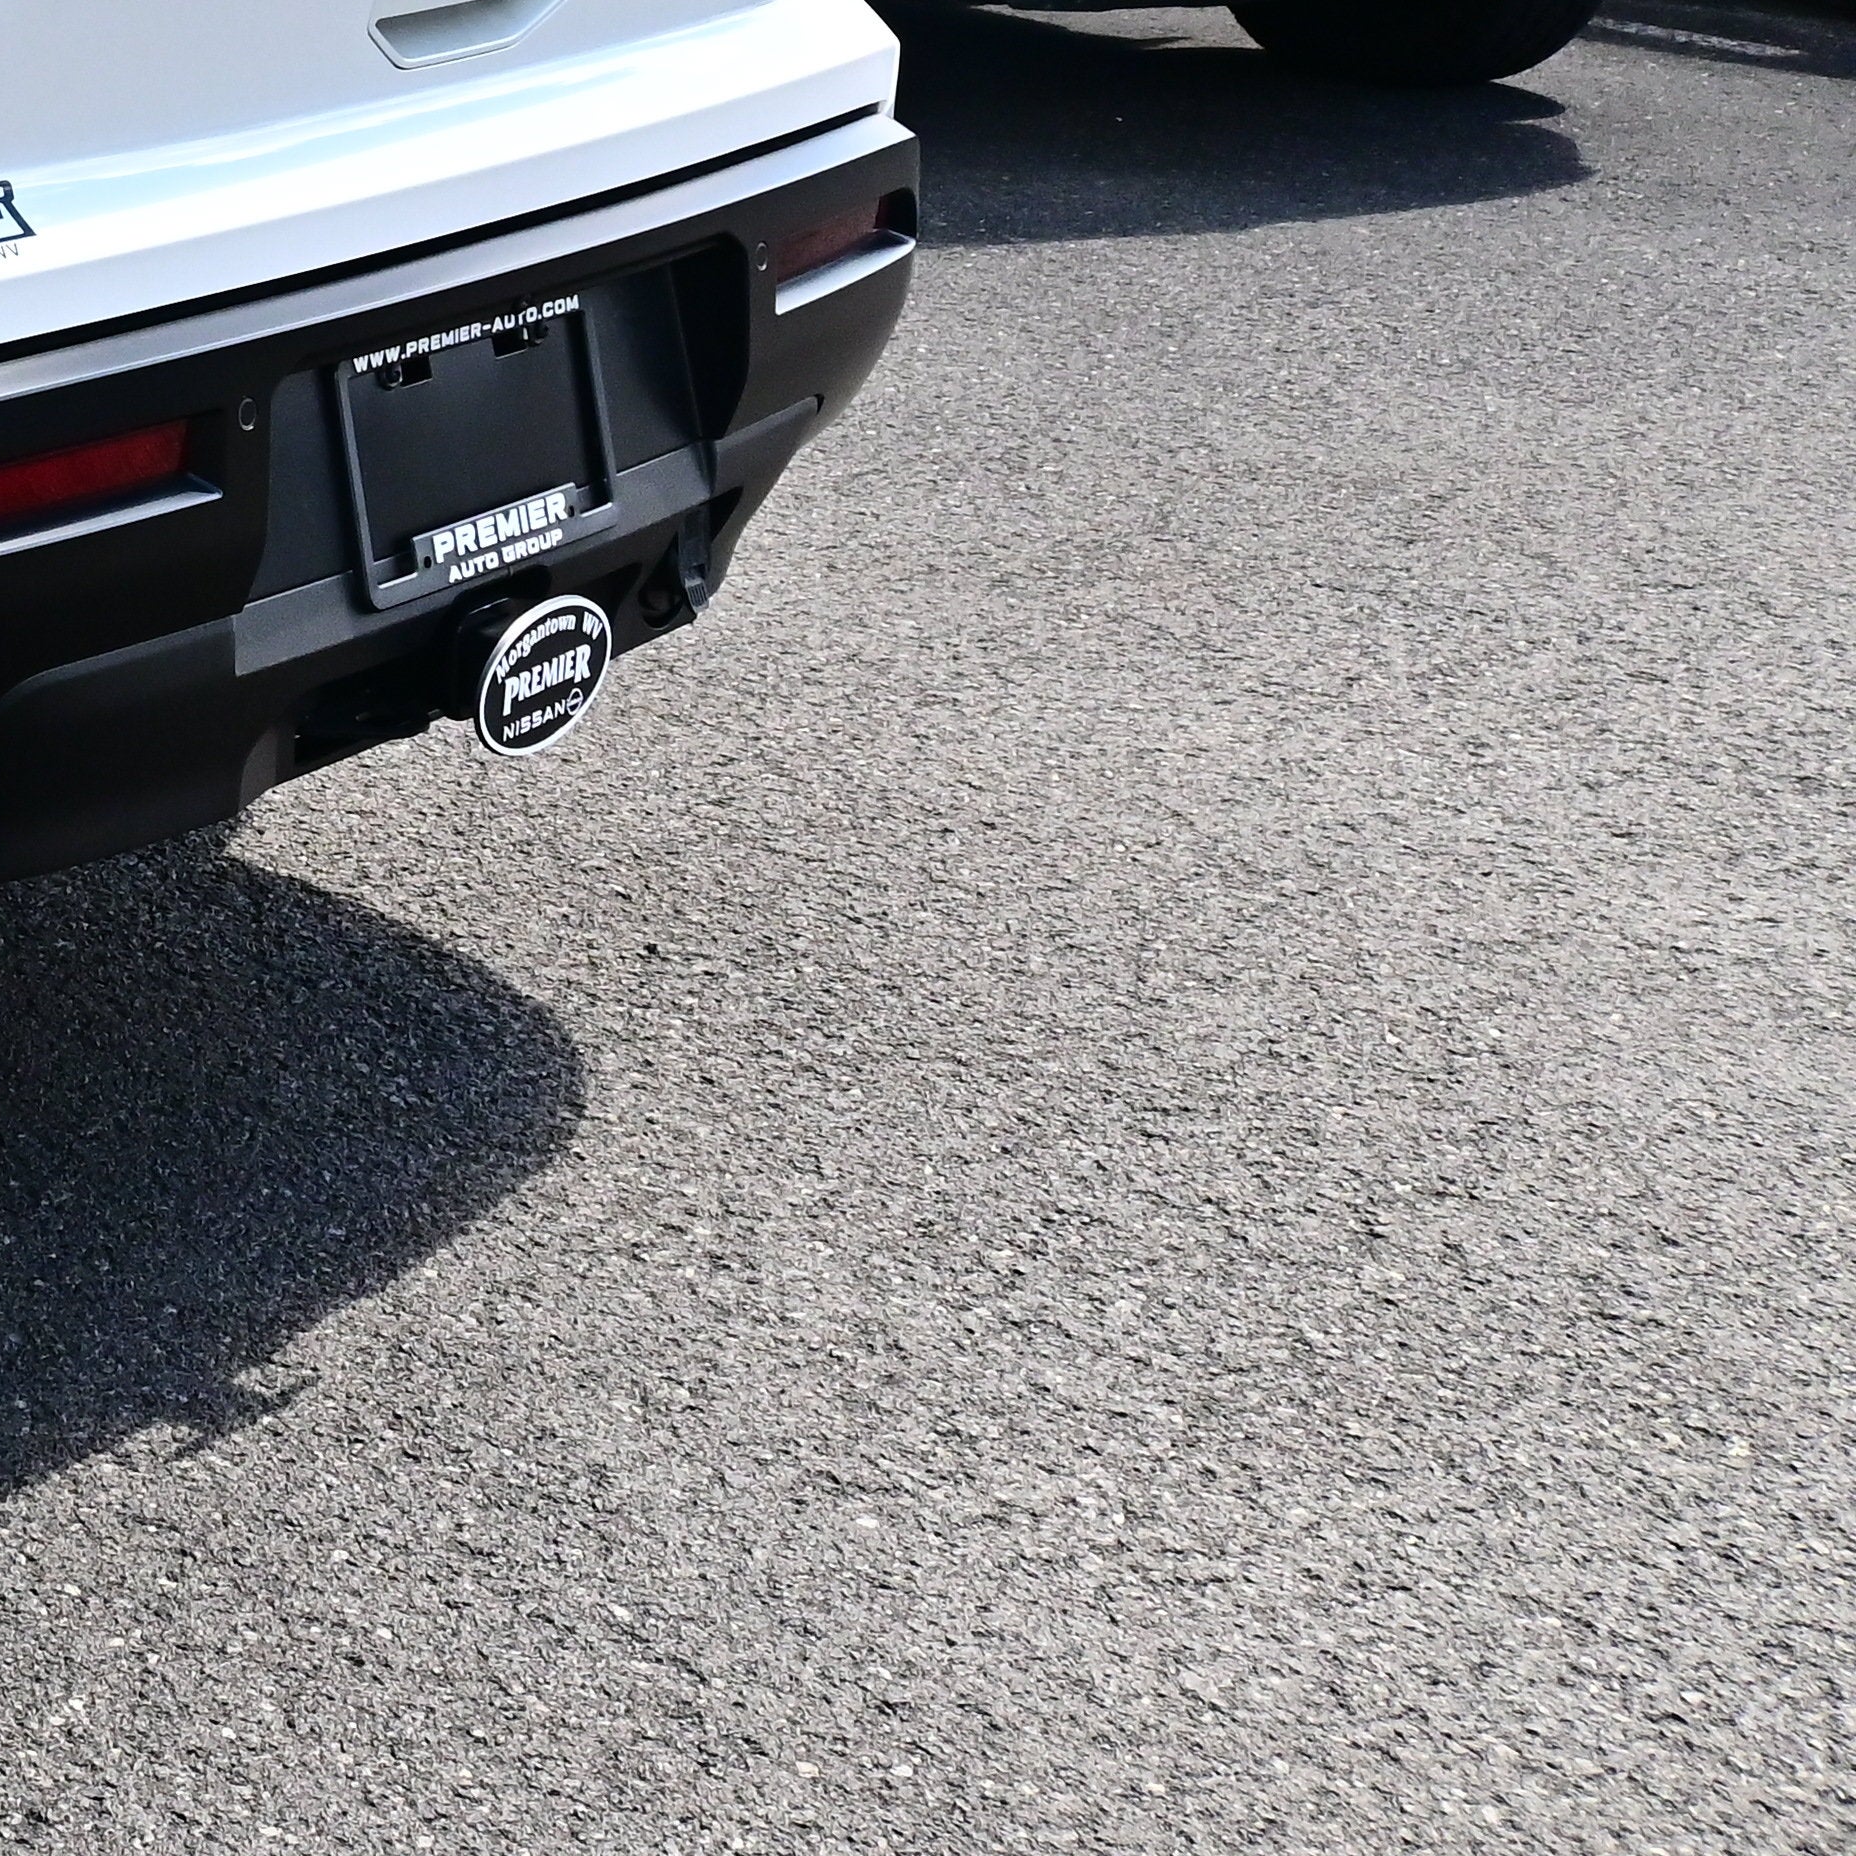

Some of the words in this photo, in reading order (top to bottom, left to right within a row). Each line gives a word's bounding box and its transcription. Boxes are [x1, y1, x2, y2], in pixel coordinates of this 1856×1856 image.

[353, 294, 580, 373] WWW.PREMIER-AUTO.COM
[432, 492, 568, 564] PREMIER
[449, 551, 499, 583] AUTO
[501, 528, 563, 564] GROUP
[496, 614, 576, 684] Morgantown
[582, 611, 603, 640] WV
[502, 644, 592, 716] PREMIER
[503, 699, 565, 742] NISSAN
